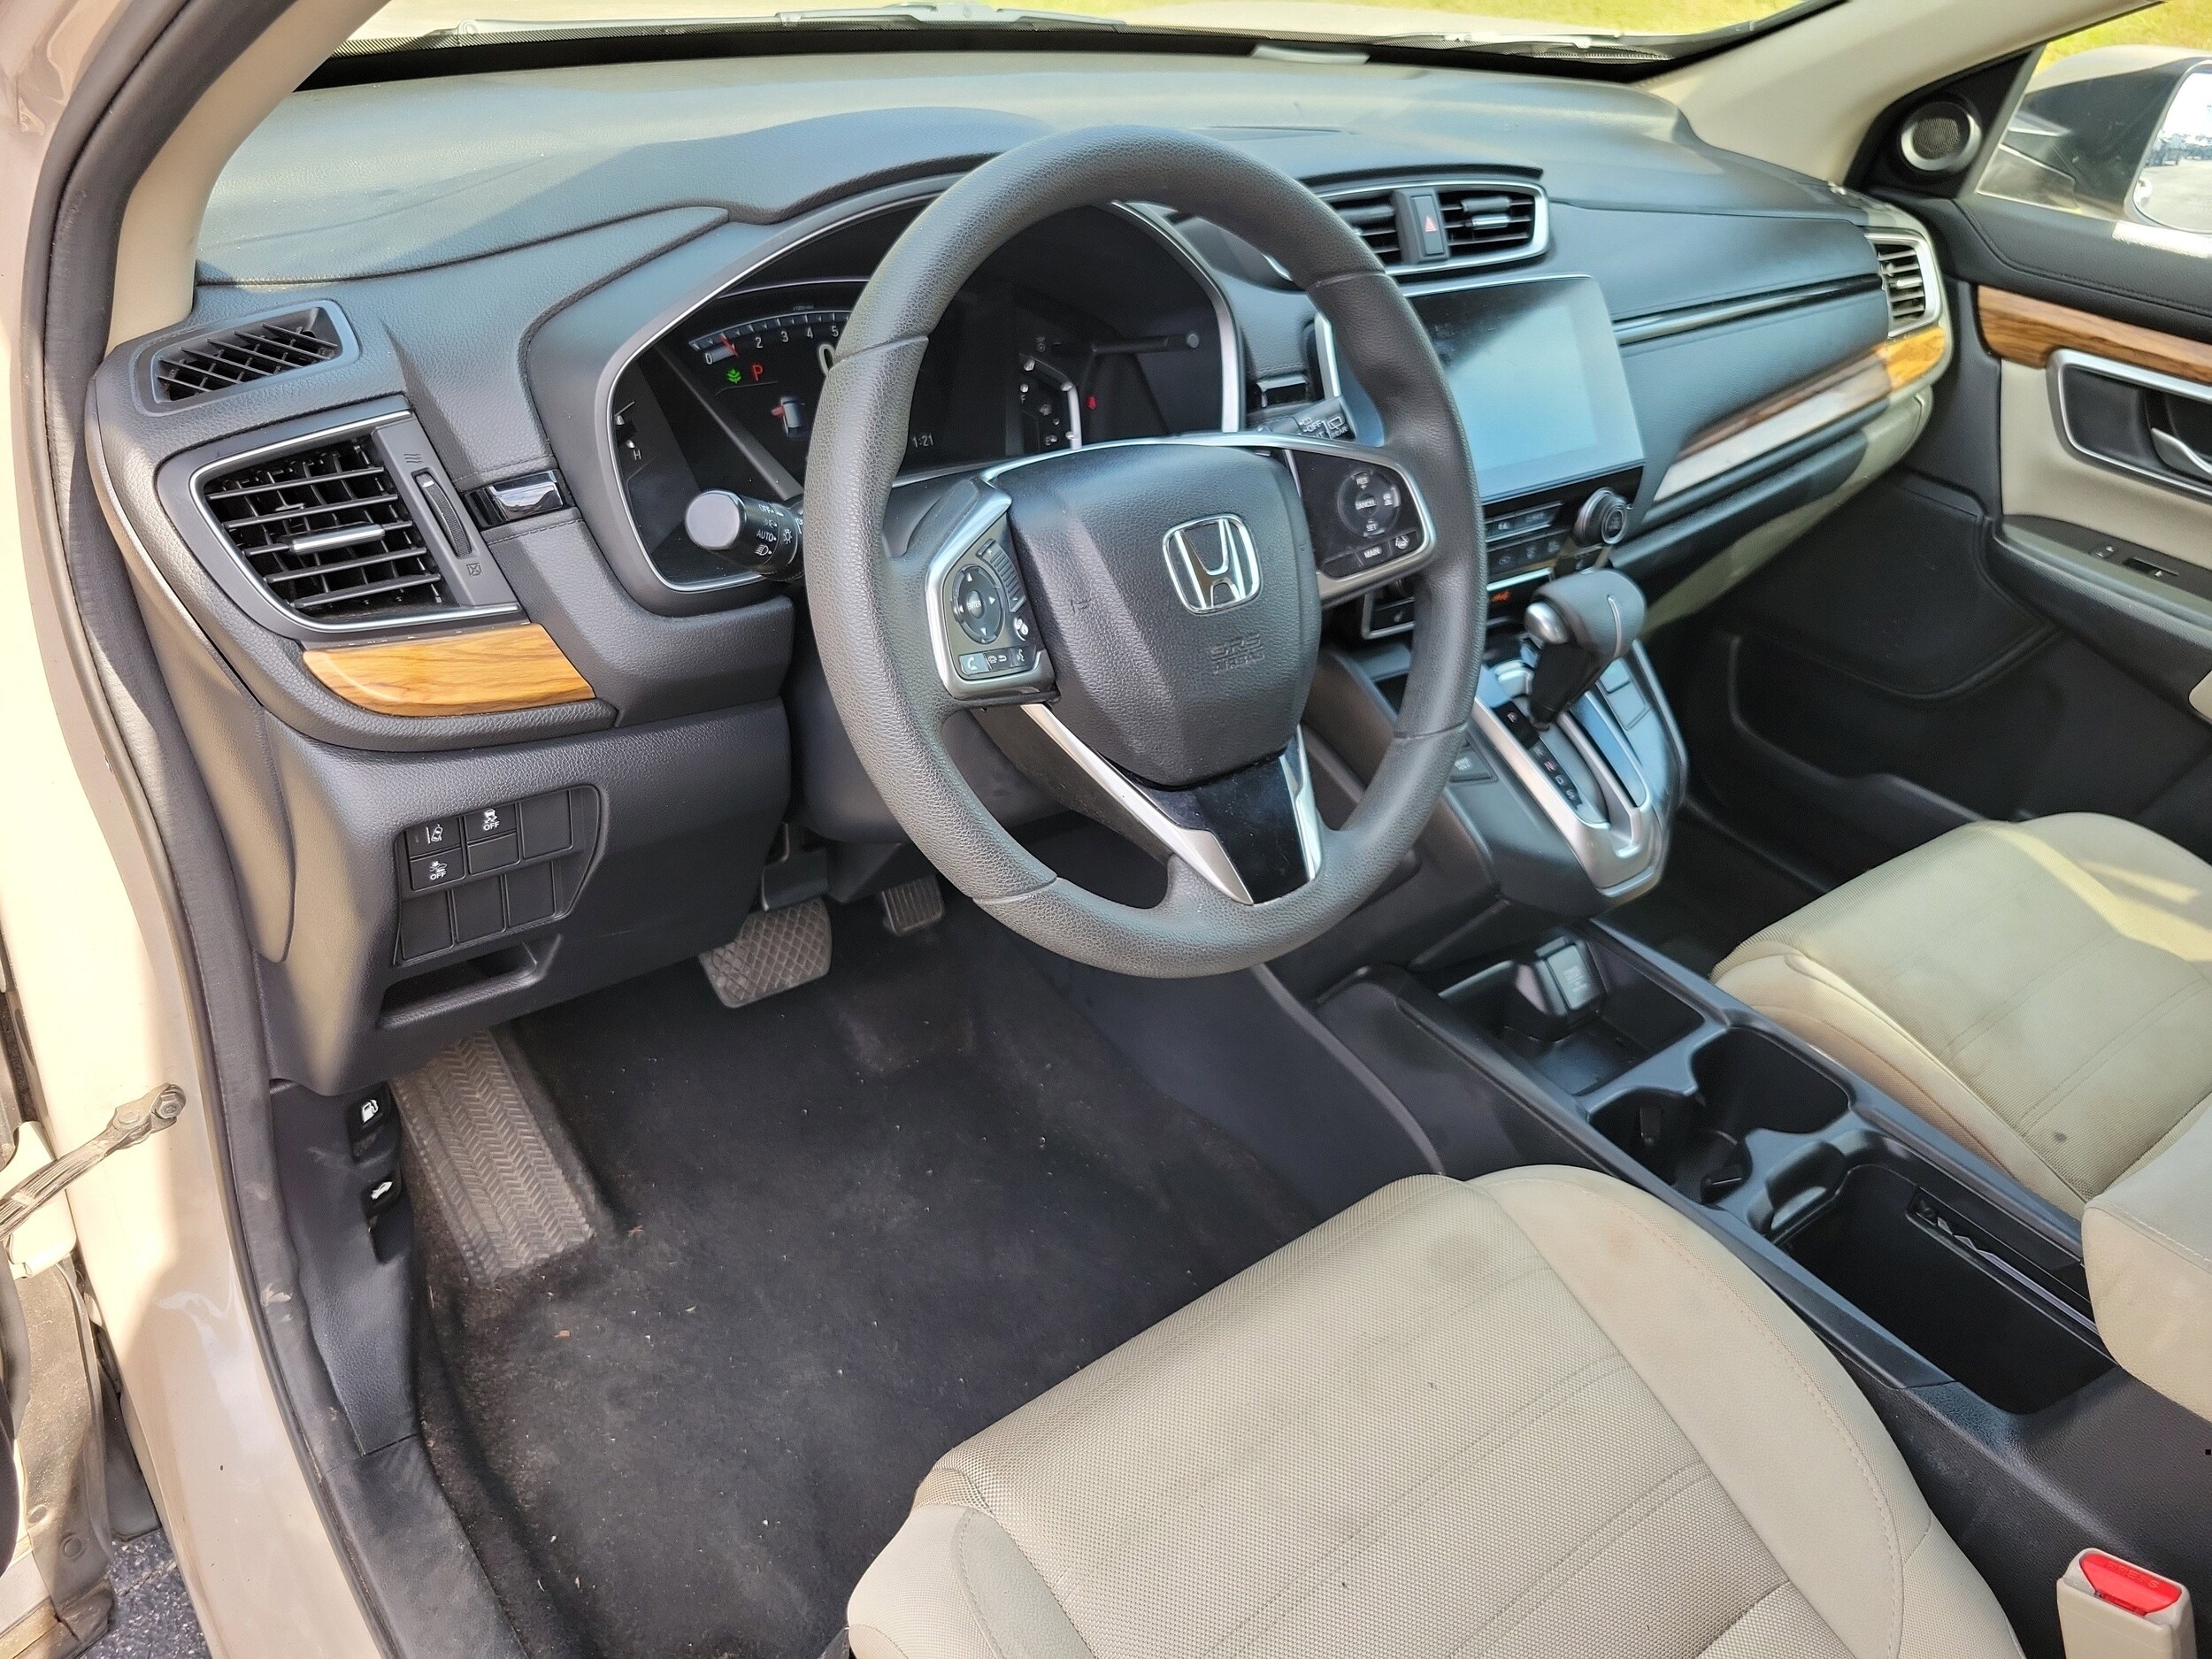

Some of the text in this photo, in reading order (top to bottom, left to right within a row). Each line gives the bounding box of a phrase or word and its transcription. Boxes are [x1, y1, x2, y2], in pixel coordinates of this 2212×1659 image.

[755, 325, 840, 349] 2 3 4 5
[752, 364, 764, 381] P
[1306, 419, 1322, 432] OFF
[912, 434, 934, 448] 1:21
[633, 449, 641, 461] H
[757, 529, 774, 542] AUTO
[1363, 546, 1382, 559] MAIN
[483, 821, 501, 831] OFF
[429, 871, 447, 880] OFF
